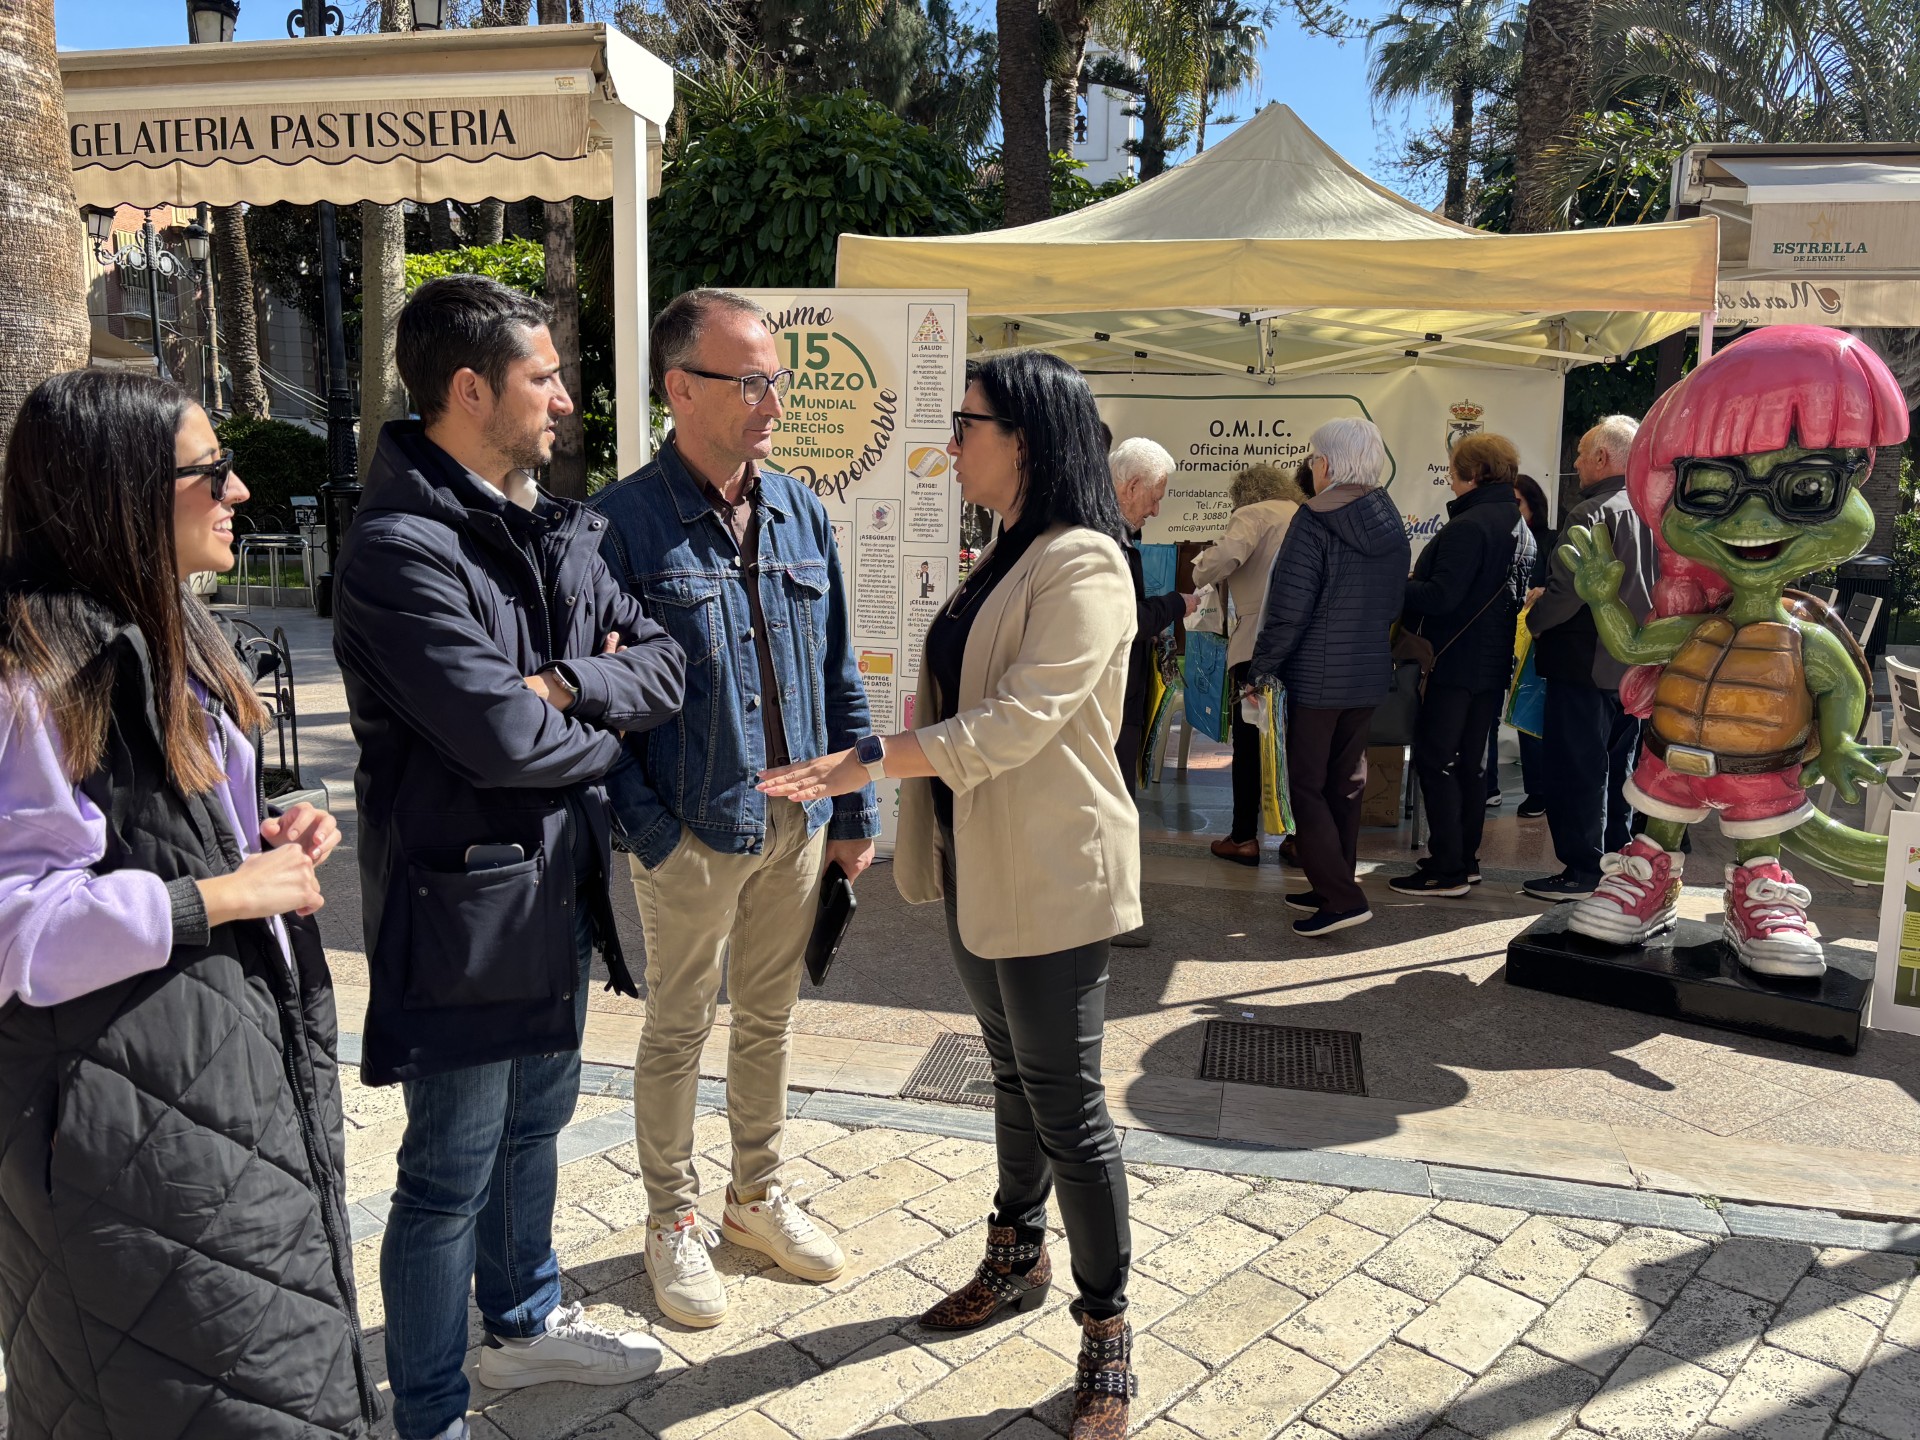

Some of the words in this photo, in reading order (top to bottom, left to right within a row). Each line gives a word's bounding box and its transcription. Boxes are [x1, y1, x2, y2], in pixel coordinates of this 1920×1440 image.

[70, 116, 255, 158] GELATERIA
[270, 108, 517, 151] PASTISSERIA
[1772, 242, 1868, 254] ESTRELLA
[761, 306, 834, 335] sumo
[783, 332, 831, 370] 15
[790, 372, 864, 391] ARZO
[786, 411, 802, 421] DE
[806, 412, 828, 422] LOS
[1209, 419, 1292, 438] O.M.I.C.
[796, 436, 818, 446] DEL
[772, 446, 855, 459] ONSUMIDOR
[1189, 443, 1239, 456] Oficina
[1244, 442, 1311, 458] Municipal
[1175, 459, 1250, 472] formación
[1272, 458, 1303, 471] Cons
[1432, 477, 1445, 486] de
[1202, 512, 1228, 520] 30880
[1167, 523, 1229, 533] omic@ayunta
